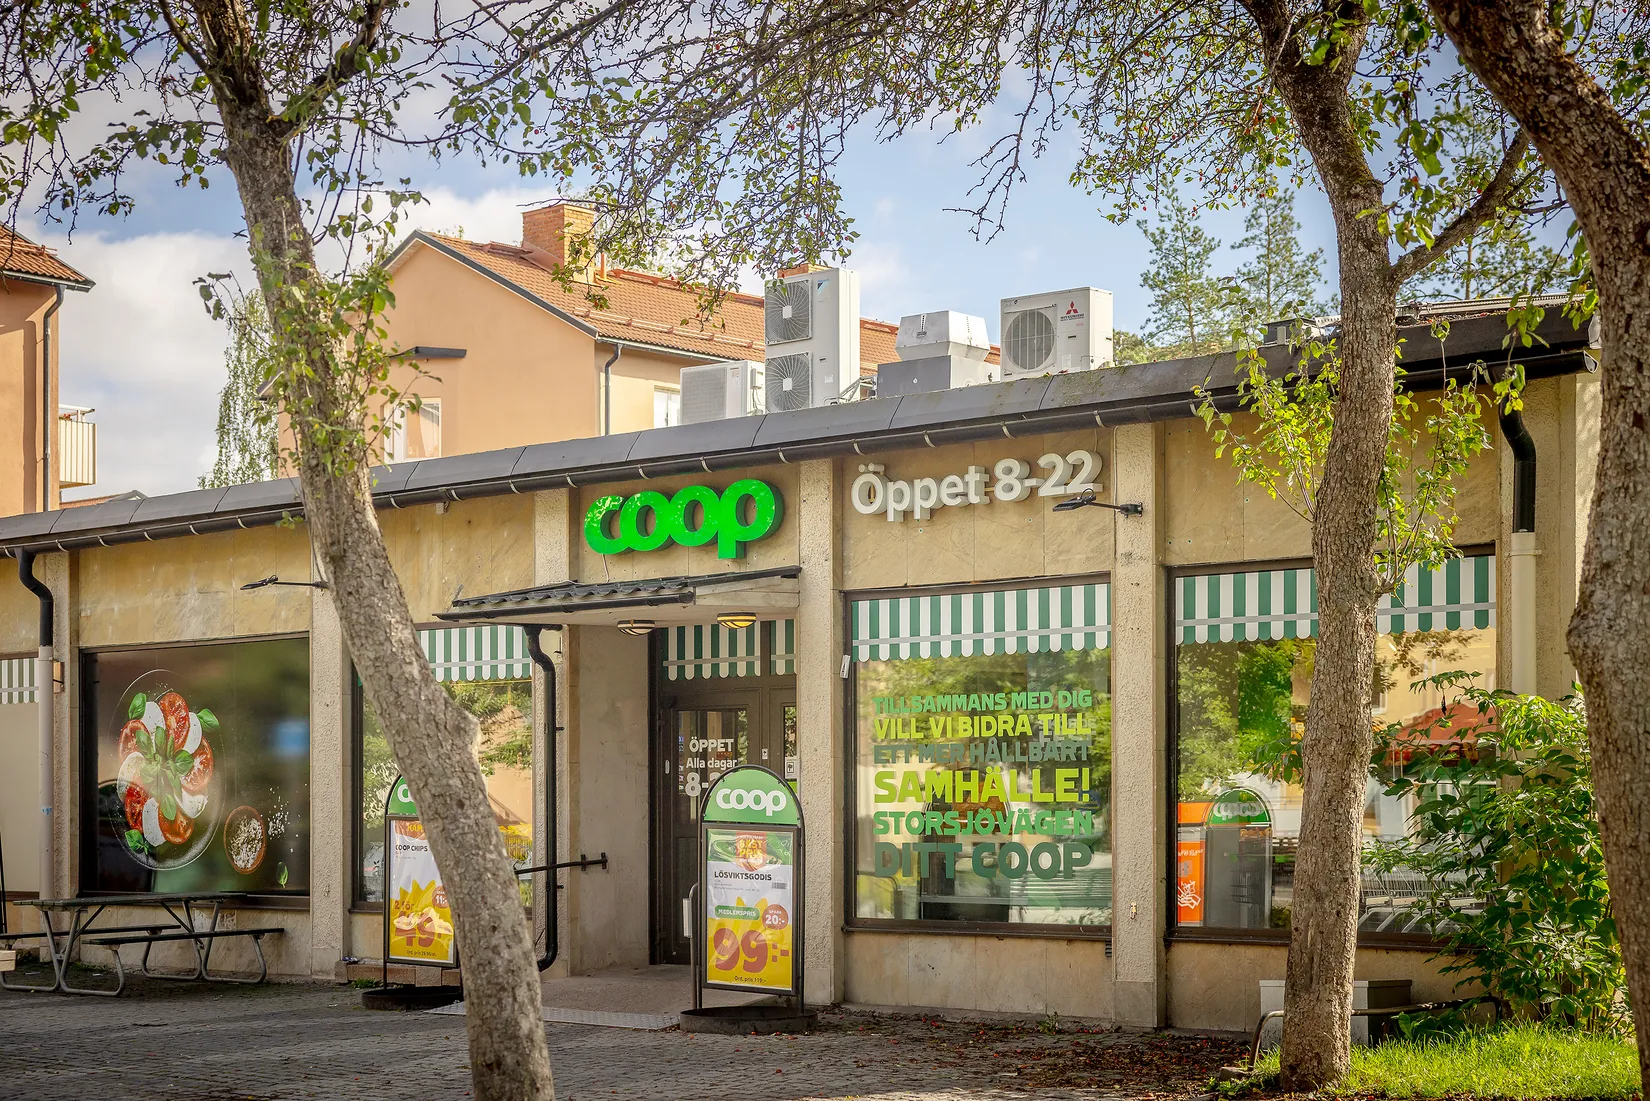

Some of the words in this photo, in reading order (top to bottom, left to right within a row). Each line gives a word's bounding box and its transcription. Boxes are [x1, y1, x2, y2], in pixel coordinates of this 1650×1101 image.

[851, 463, 990, 522] Öppet
[993, 450, 1103, 501] 8-22
[584, 479, 783, 559] coop
[874, 693, 1007, 714] TILLSAMMANS
[1012, 691, 1053, 710] MED
[1058, 690, 1092, 709] DIG
[874, 717, 924, 739] VILL
[929, 717, 952, 738] VI
[958, 715, 1032, 738] BIDRA
[1037, 713, 1092, 736] TILL
[689, 736, 734, 752] ÖPPET
[874, 744, 911, 764] ETT
[919, 743, 965, 764] MER
[970, 737, 1089, 763] HÅLLBART
[686, 758, 705, 768] Alla
[707, 758, 737, 770] dagar
[874, 766, 1090, 803] SAMHÄLLE!
[716, 788, 787, 817] coop
[873, 808, 1092, 835] STORSJÖVÄGEN
[874, 842, 962, 878] DITT
[972, 842, 1093, 879] COOP
[714, 870, 772, 881] LÖSVIKTSGODIS
[394, 900, 400, 910] 2
